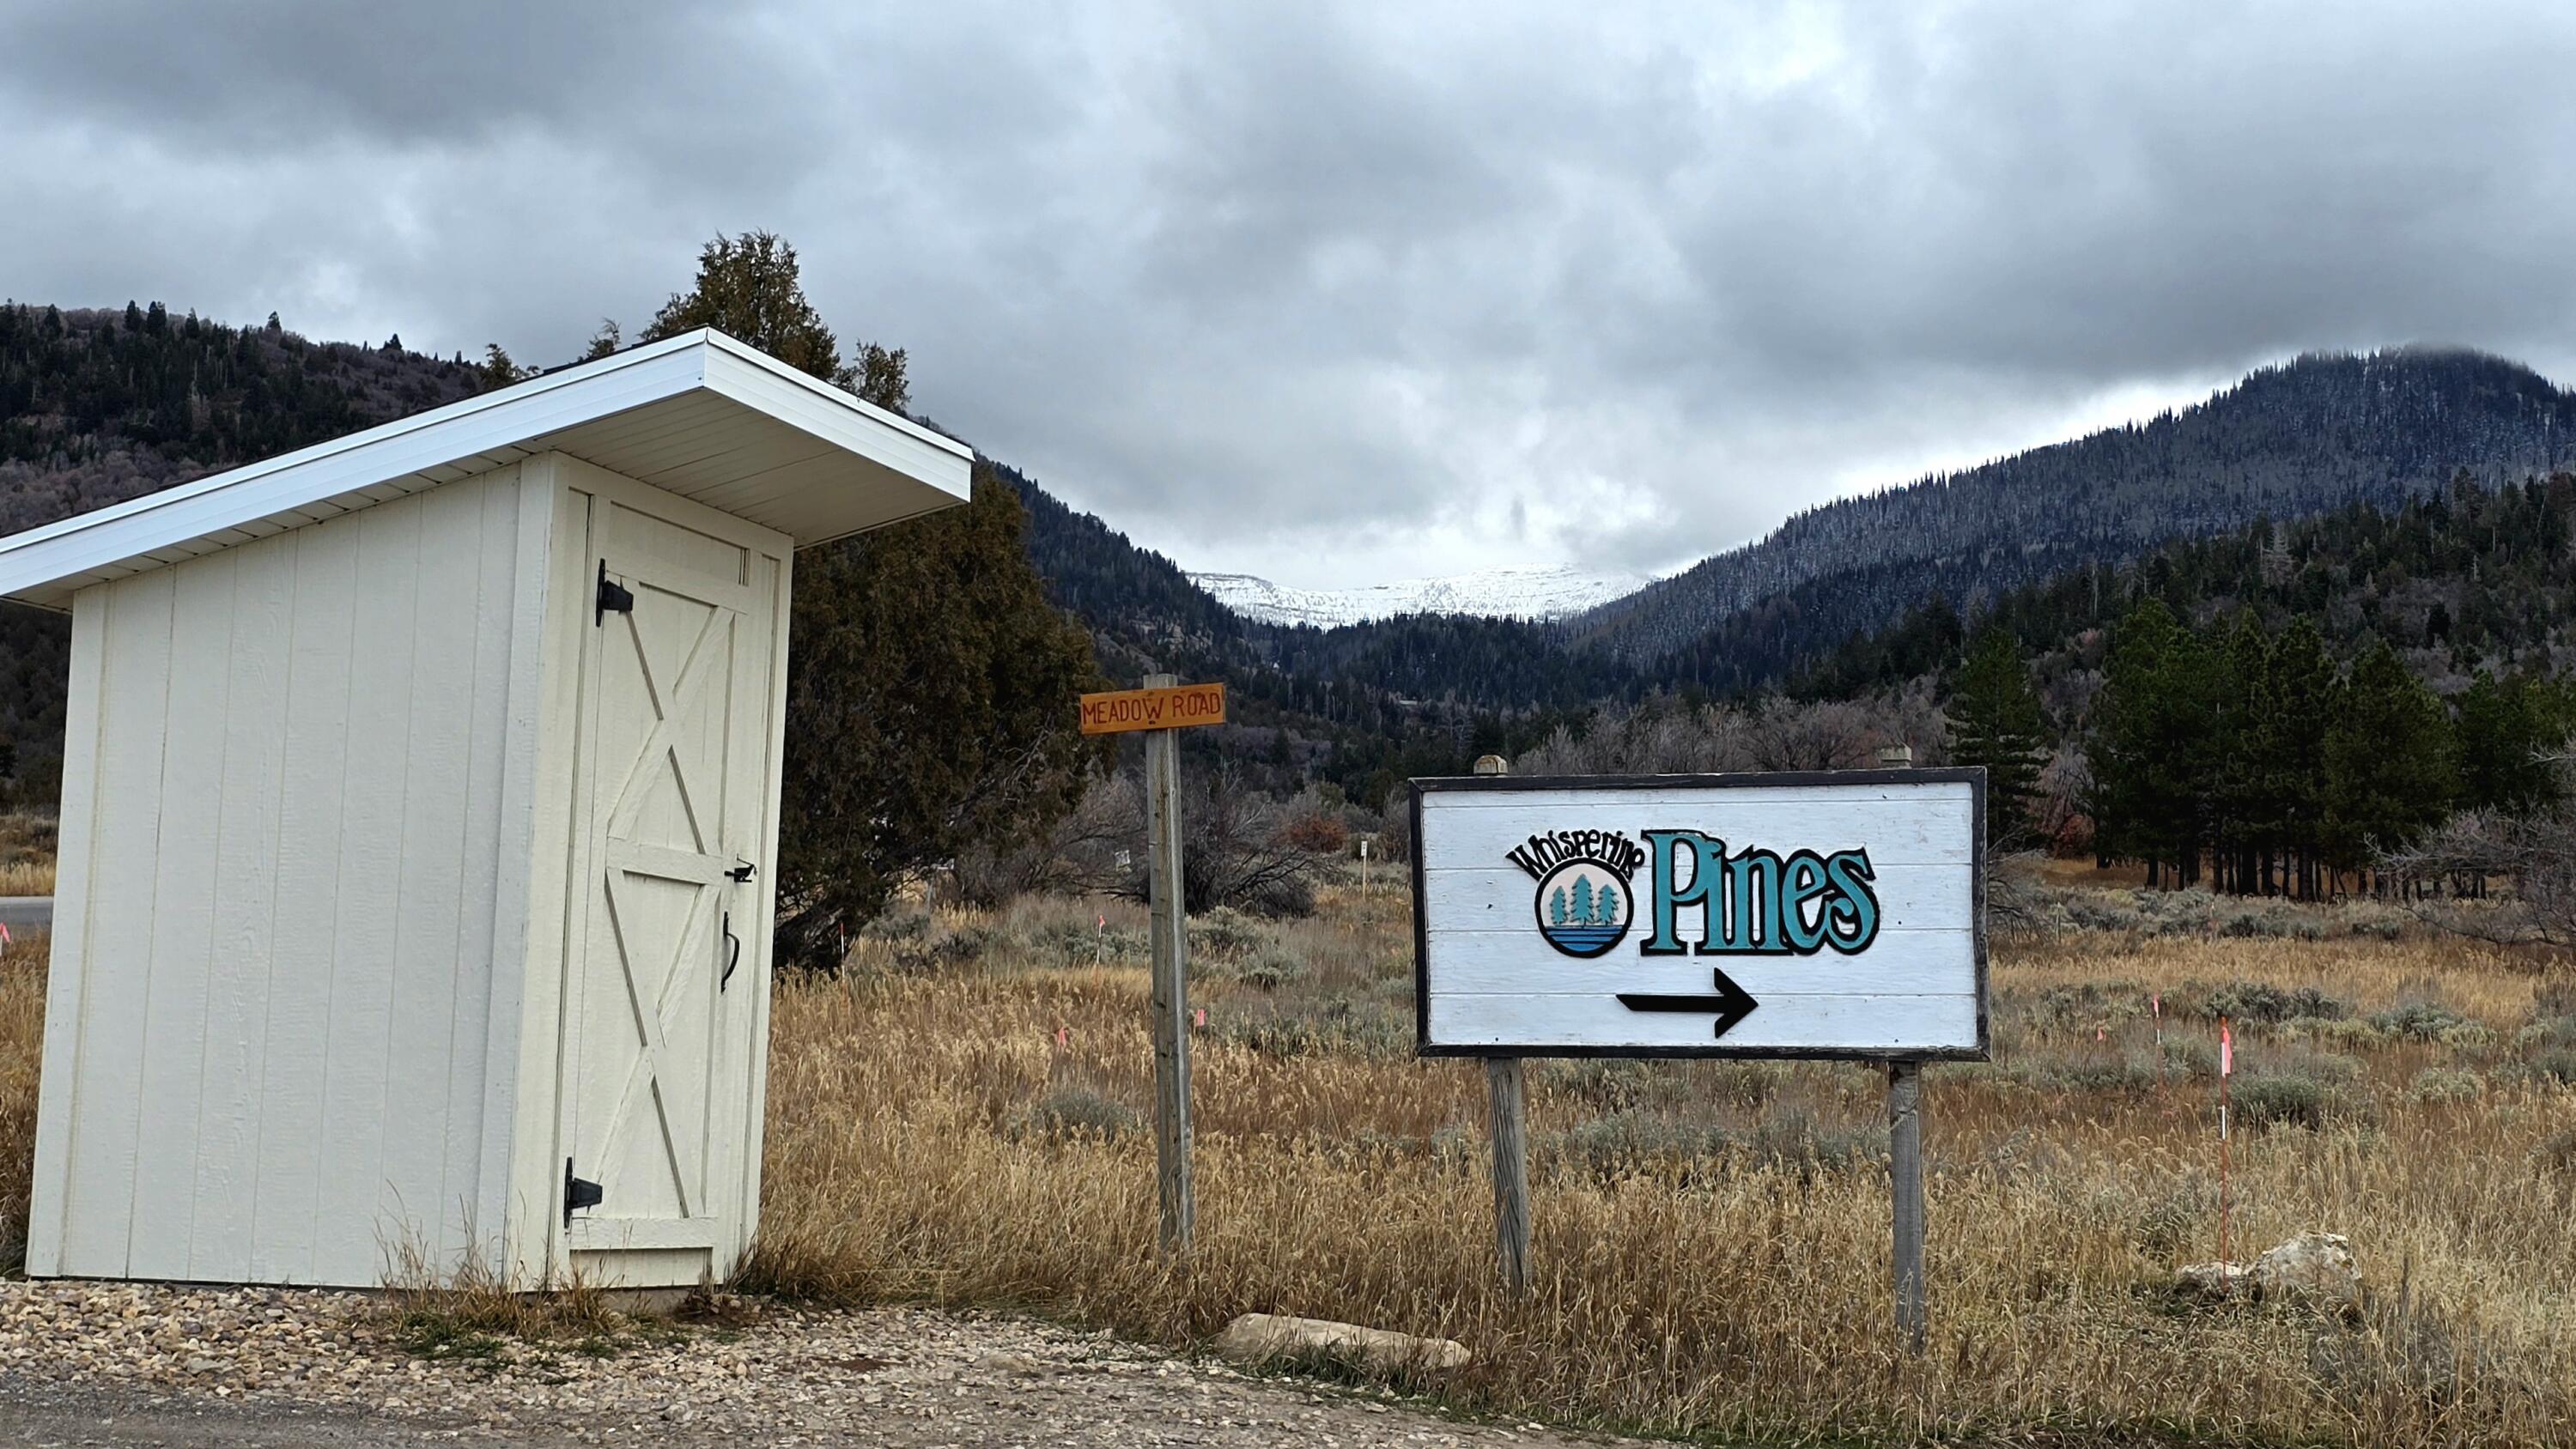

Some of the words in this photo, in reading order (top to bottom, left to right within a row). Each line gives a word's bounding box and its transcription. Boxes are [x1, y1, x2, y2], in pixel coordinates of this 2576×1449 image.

[1082, 697, 1164, 724] MEADOW
[1172, 692, 1221, 718] ROAD
[1505, 828, 1645, 882] Whispering
[1640, 829, 1880, 955] Pines
